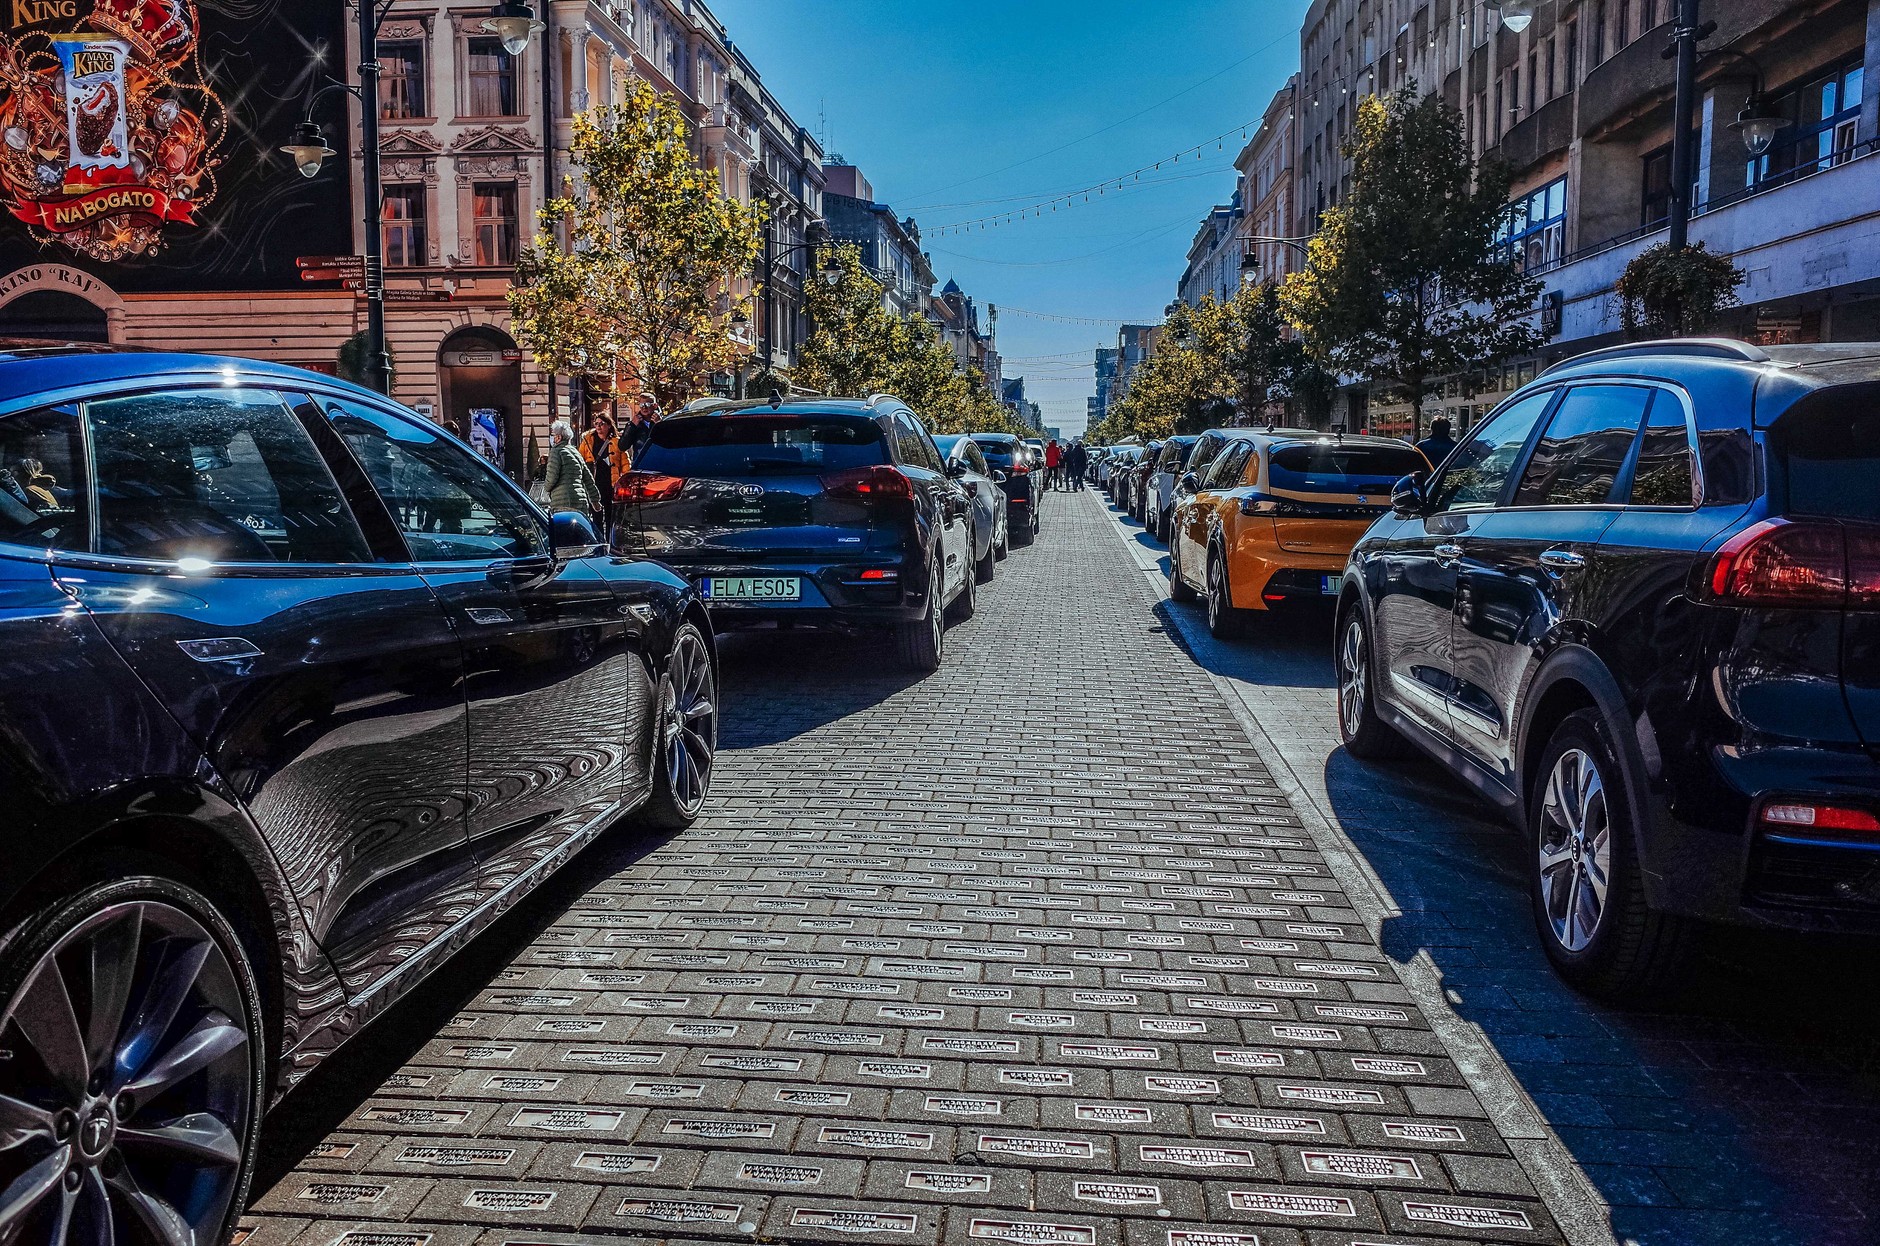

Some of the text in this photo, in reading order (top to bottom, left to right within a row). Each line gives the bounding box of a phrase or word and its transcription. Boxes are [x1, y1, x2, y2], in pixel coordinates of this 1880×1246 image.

[11, 0, 76, 28] KING
[87, 52, 113, 60] MAXI
[74, 52, 114, 78] KING
[55, 190, 156, 224] NA BOGATO
[0, 268, 42, 297] KINO
[714, 580, 795, 596] ELA ES05
[869, 1137, 922, 1146] AGNIESZKA
[1007, 1140, 1066, 1148] MARKOWSKI
[1033, 1146, 1080, 1154] WOJCIECH
[1166, 1148, 1225, 1156] MARKOWSKI
[1080, 1184, 1154, 1195] KWIATKOWSKI
[1410, 1211, 1470, 1222] WALDEMAR
[1430, 1207, 1500, 1218] BEDNARCZYK
[991, 1230, 1032, 1238] MARCIN
[1038, 1232, 1075, 1241] ALICJA
[1187, 1234, 1240, 1243] ANDREWS
